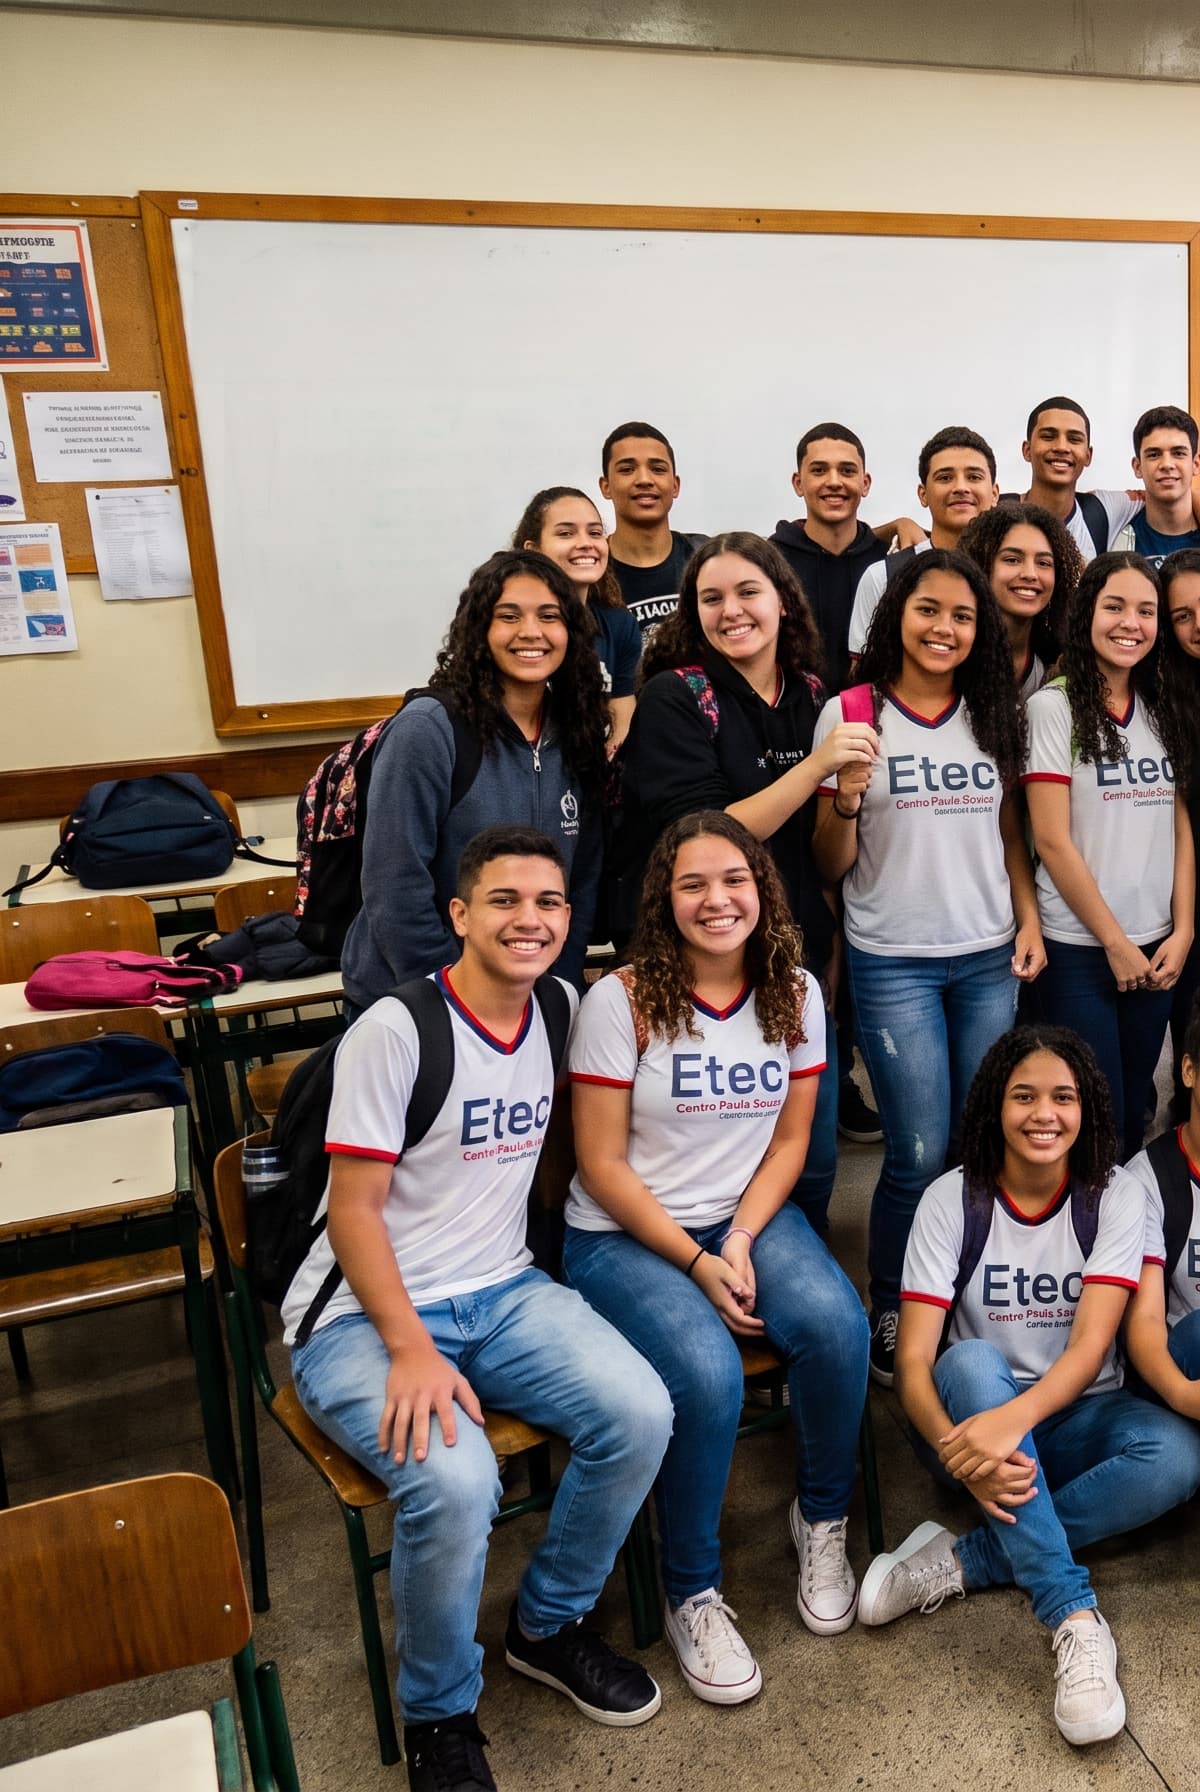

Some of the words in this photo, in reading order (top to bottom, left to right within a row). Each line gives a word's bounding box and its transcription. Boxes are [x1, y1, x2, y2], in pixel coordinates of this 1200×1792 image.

[887, 754, 995, 795] Etec
[671, 1053, 783, 1098] Etec
[460, 1095, 550, 1146] Etec
[676, 1103, 717, 1113] Centro
[719, 1099, 751, 1110] Paula
[982, 1263, 1083, 1307] Etec
